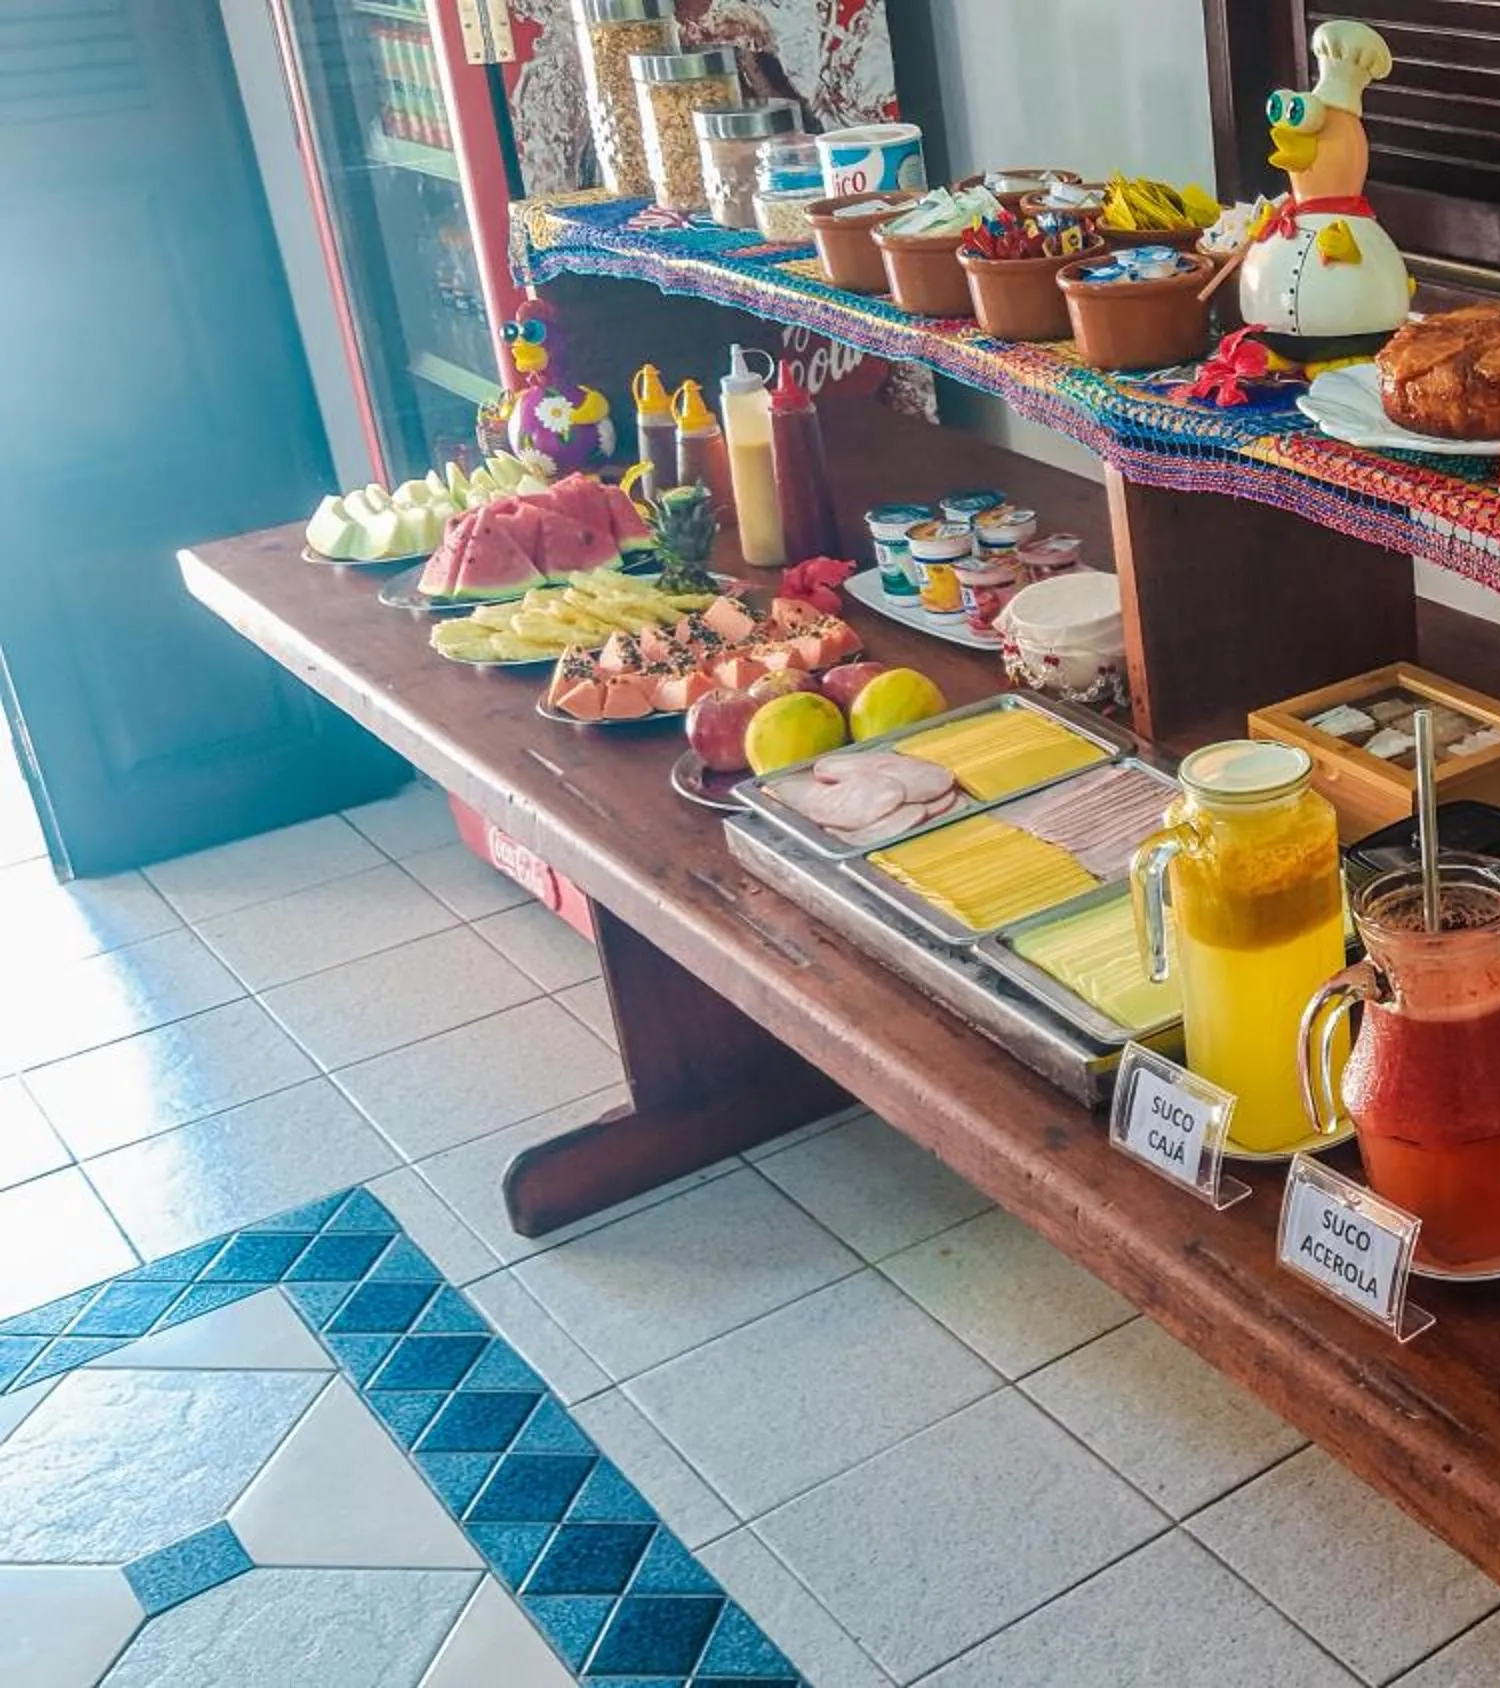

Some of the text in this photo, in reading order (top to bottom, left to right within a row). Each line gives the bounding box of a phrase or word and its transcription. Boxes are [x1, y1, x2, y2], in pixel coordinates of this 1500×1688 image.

[1151, 1095, 1195, 1133] SUCO
[1147, 1129, 1186, 1165] CAJÁ
[1321, 1209, 1371, 1252] SUCO
[1300, 1235, 1379, 1299] ACEROLA
